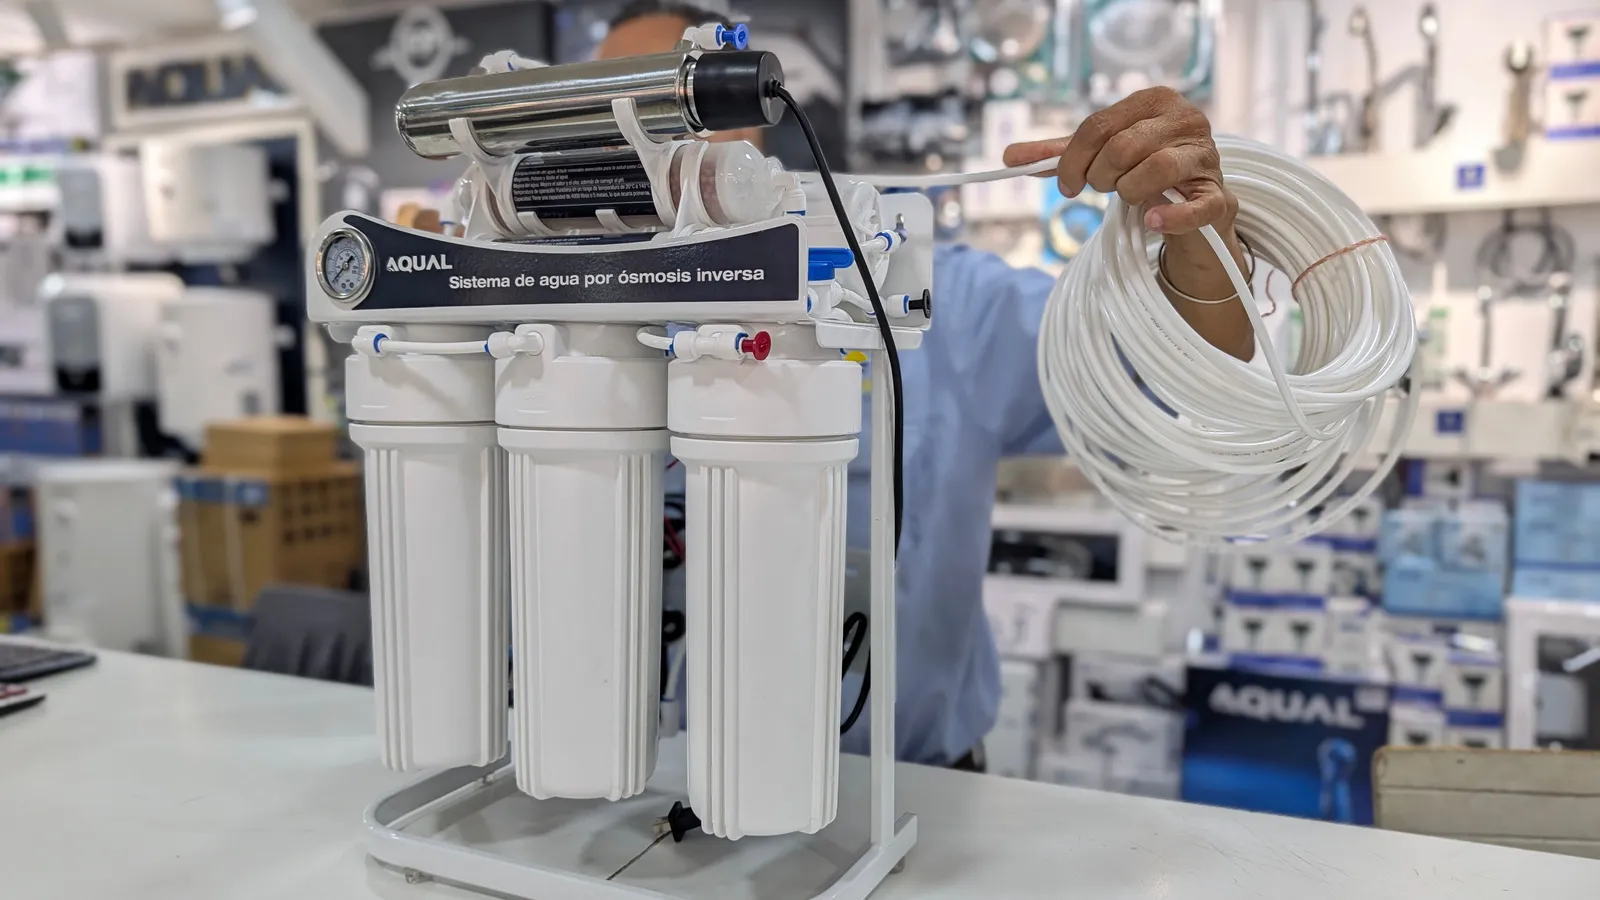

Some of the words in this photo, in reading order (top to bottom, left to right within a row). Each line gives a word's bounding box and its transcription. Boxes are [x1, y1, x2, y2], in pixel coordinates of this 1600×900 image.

[386, 254, 452, 273] AQUAL
[449, 276, 510, 289] Sistema
[514, 273, 535, 287] de
[539, 274, 580, 289] agua
[584, 274, 613, 288] por
[618, 268, 692, 284] ósmosis
[696, 268, 764, 282] inversa
[1209, 682, 1365, 729] AQUAL
